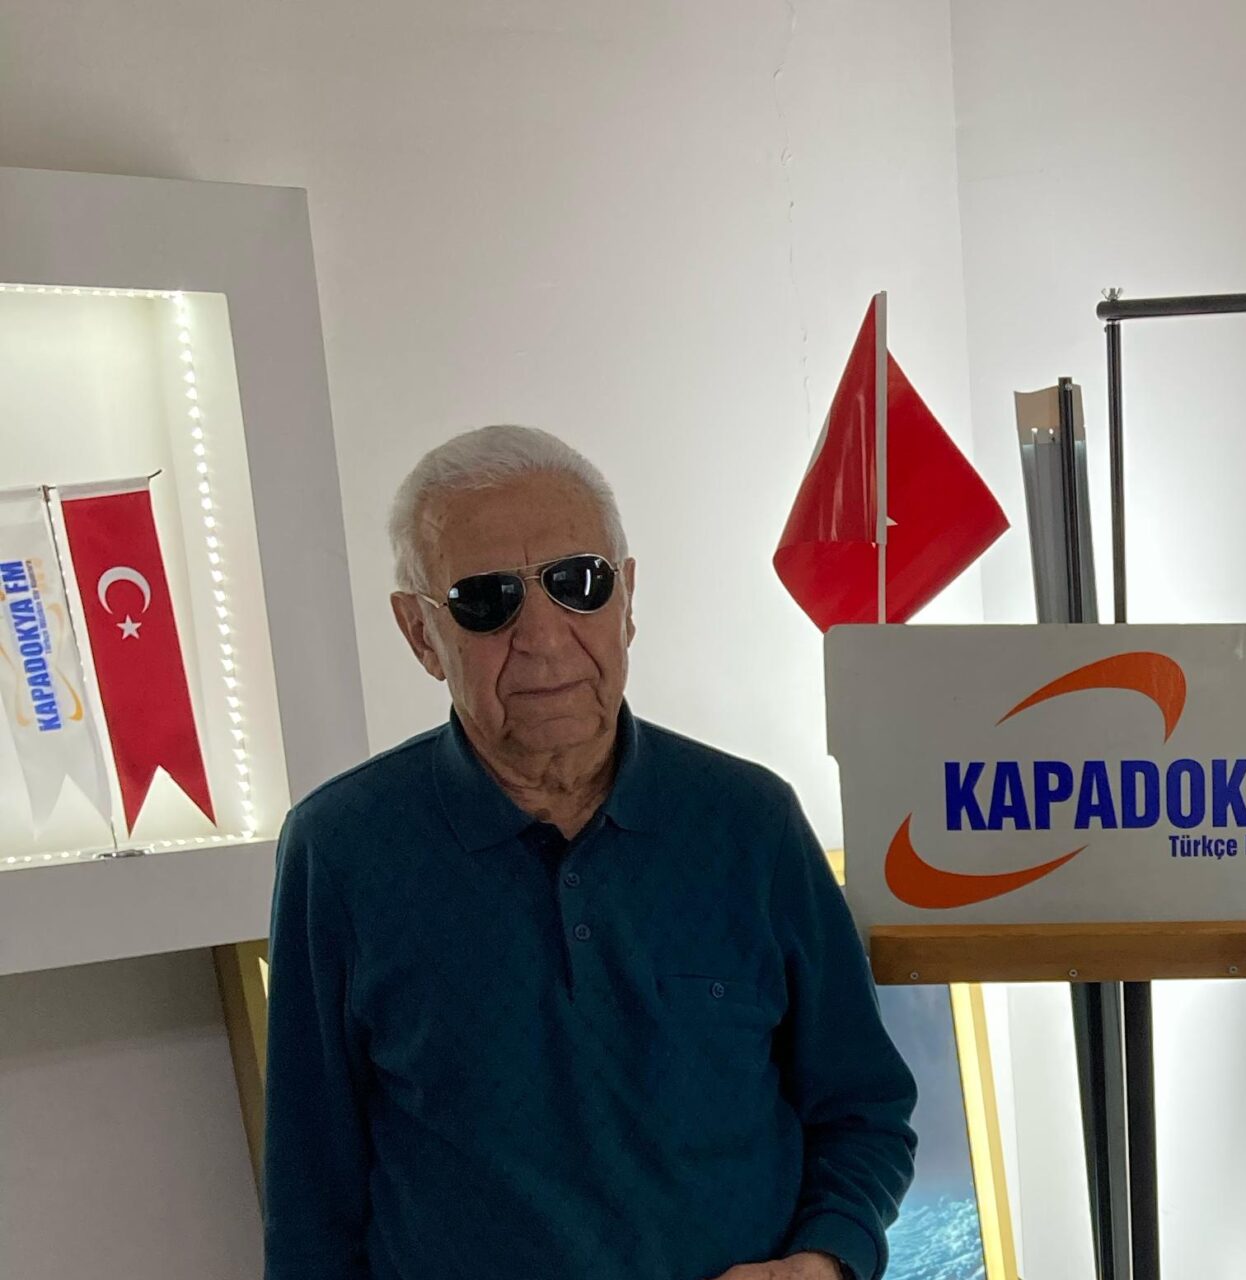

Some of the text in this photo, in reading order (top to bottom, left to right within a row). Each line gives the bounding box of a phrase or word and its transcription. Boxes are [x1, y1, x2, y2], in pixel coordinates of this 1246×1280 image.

[0, 560, 62, 732] KAPADOKYA FM
[1168, 835, 1238, 860] Türkçe
